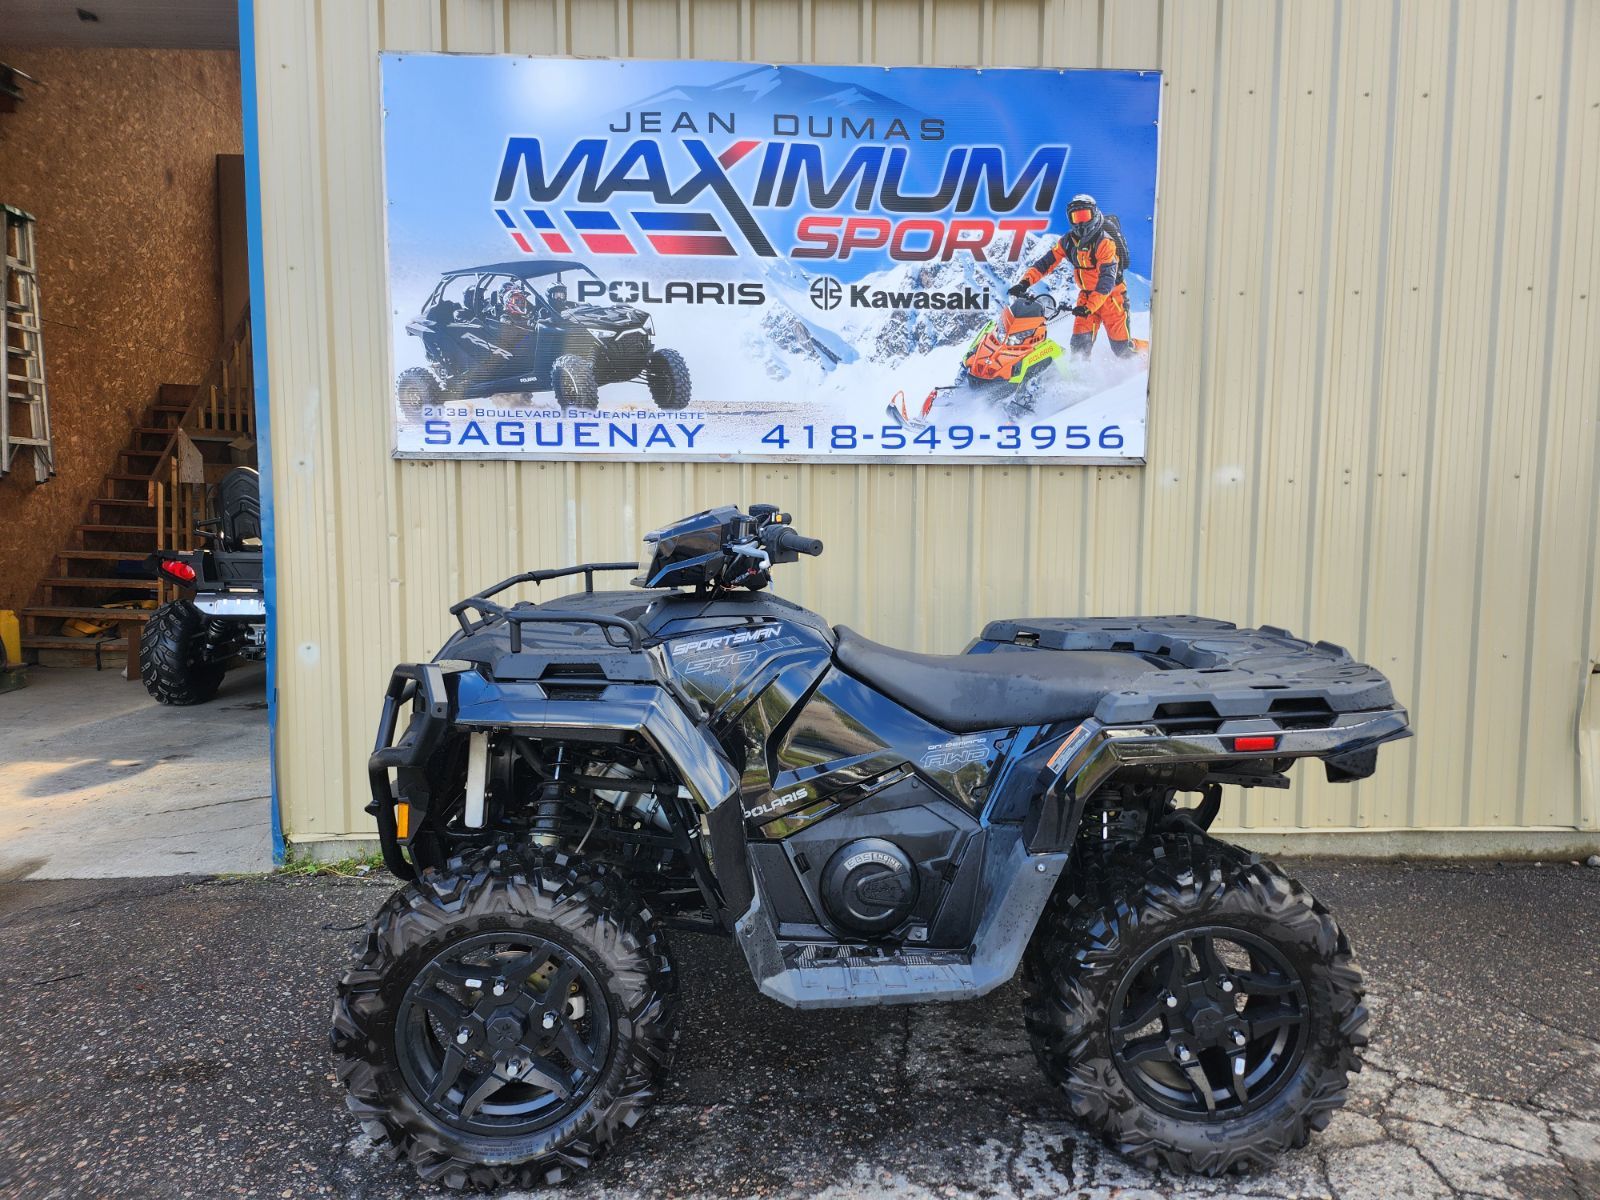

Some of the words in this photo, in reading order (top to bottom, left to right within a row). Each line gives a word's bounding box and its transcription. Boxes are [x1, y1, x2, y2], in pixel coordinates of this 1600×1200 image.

[609, 111, 735, 134] JEAN
[773, 114, 945, 141] DUMAS
[493, 136, 1070, 257] MAXIMUM
[790, 216, 1049, 263] SPORT
[577, 280, 766, 305] POLARIS
[851, 285, 990, 310] Kawasaki
[424, 407, 468, 418] 2138
[424, 420, 705, 448] SAGUENAY
[761, 424, 1124, 450] 418-549-3956
[672, 626, 782, 656] SPORTSMAN
[924, 748, 990, 768] AWD
